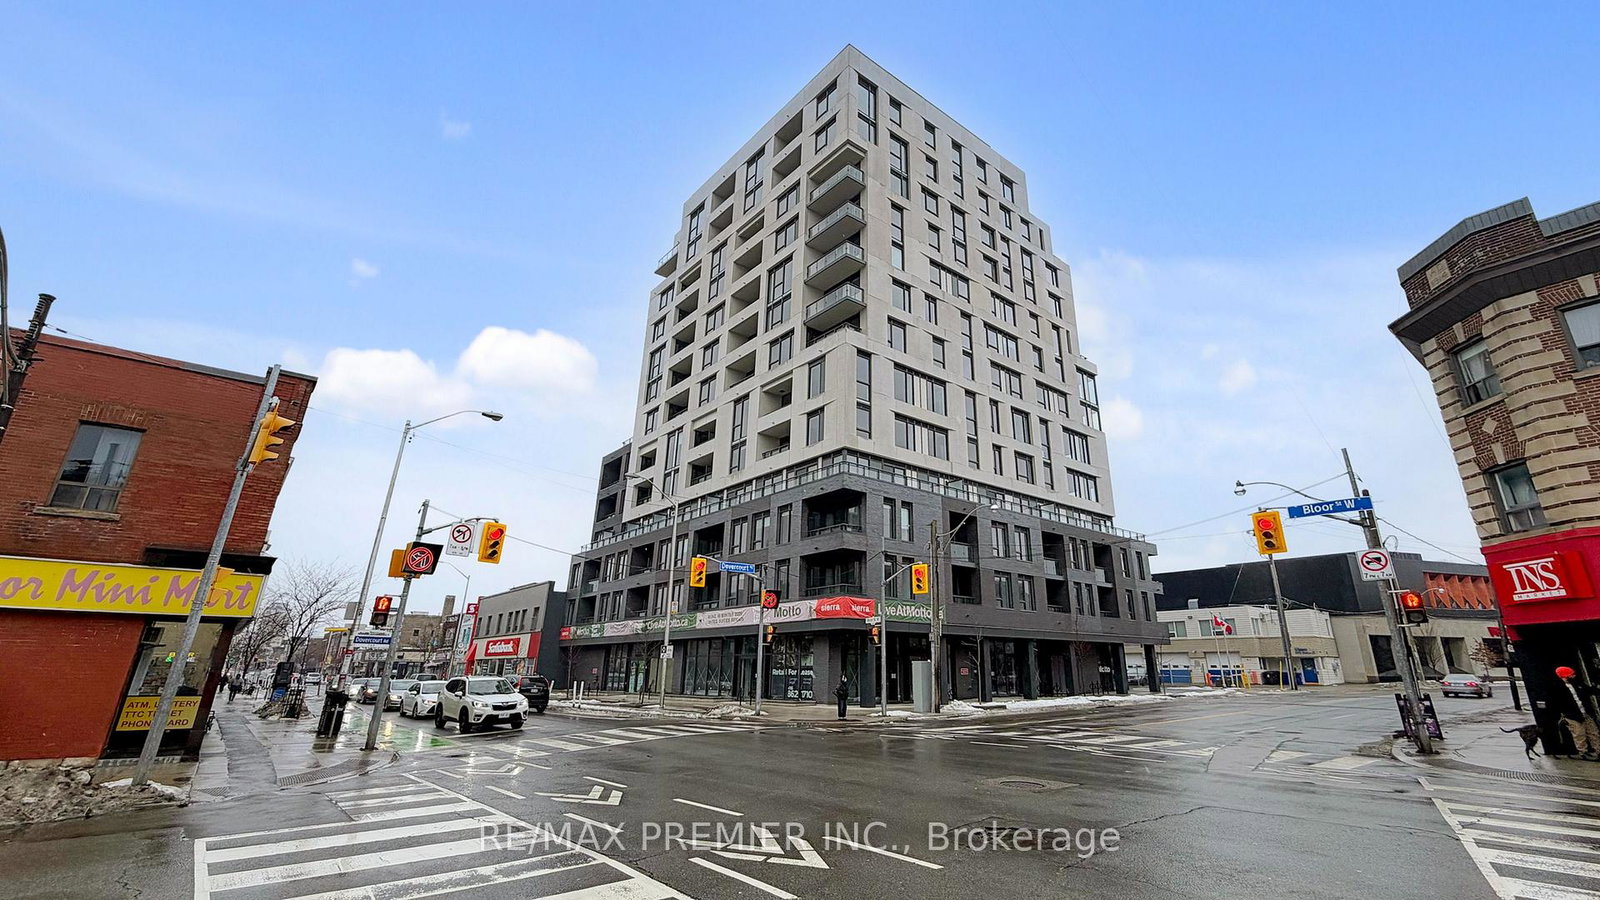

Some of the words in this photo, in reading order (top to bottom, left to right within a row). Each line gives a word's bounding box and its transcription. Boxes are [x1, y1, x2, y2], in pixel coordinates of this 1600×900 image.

[1302, 502, 1334, 514] Bloor
[1343, 499, 1355, 508] W
[1506, 562, 1561, 593] INS
[56, 568, 159, 605] Mini
[355, 636, 382, 644] Dovercourt
[155, 700, 198, 709] LTERY
[147, 710, 183, 718] TIET
